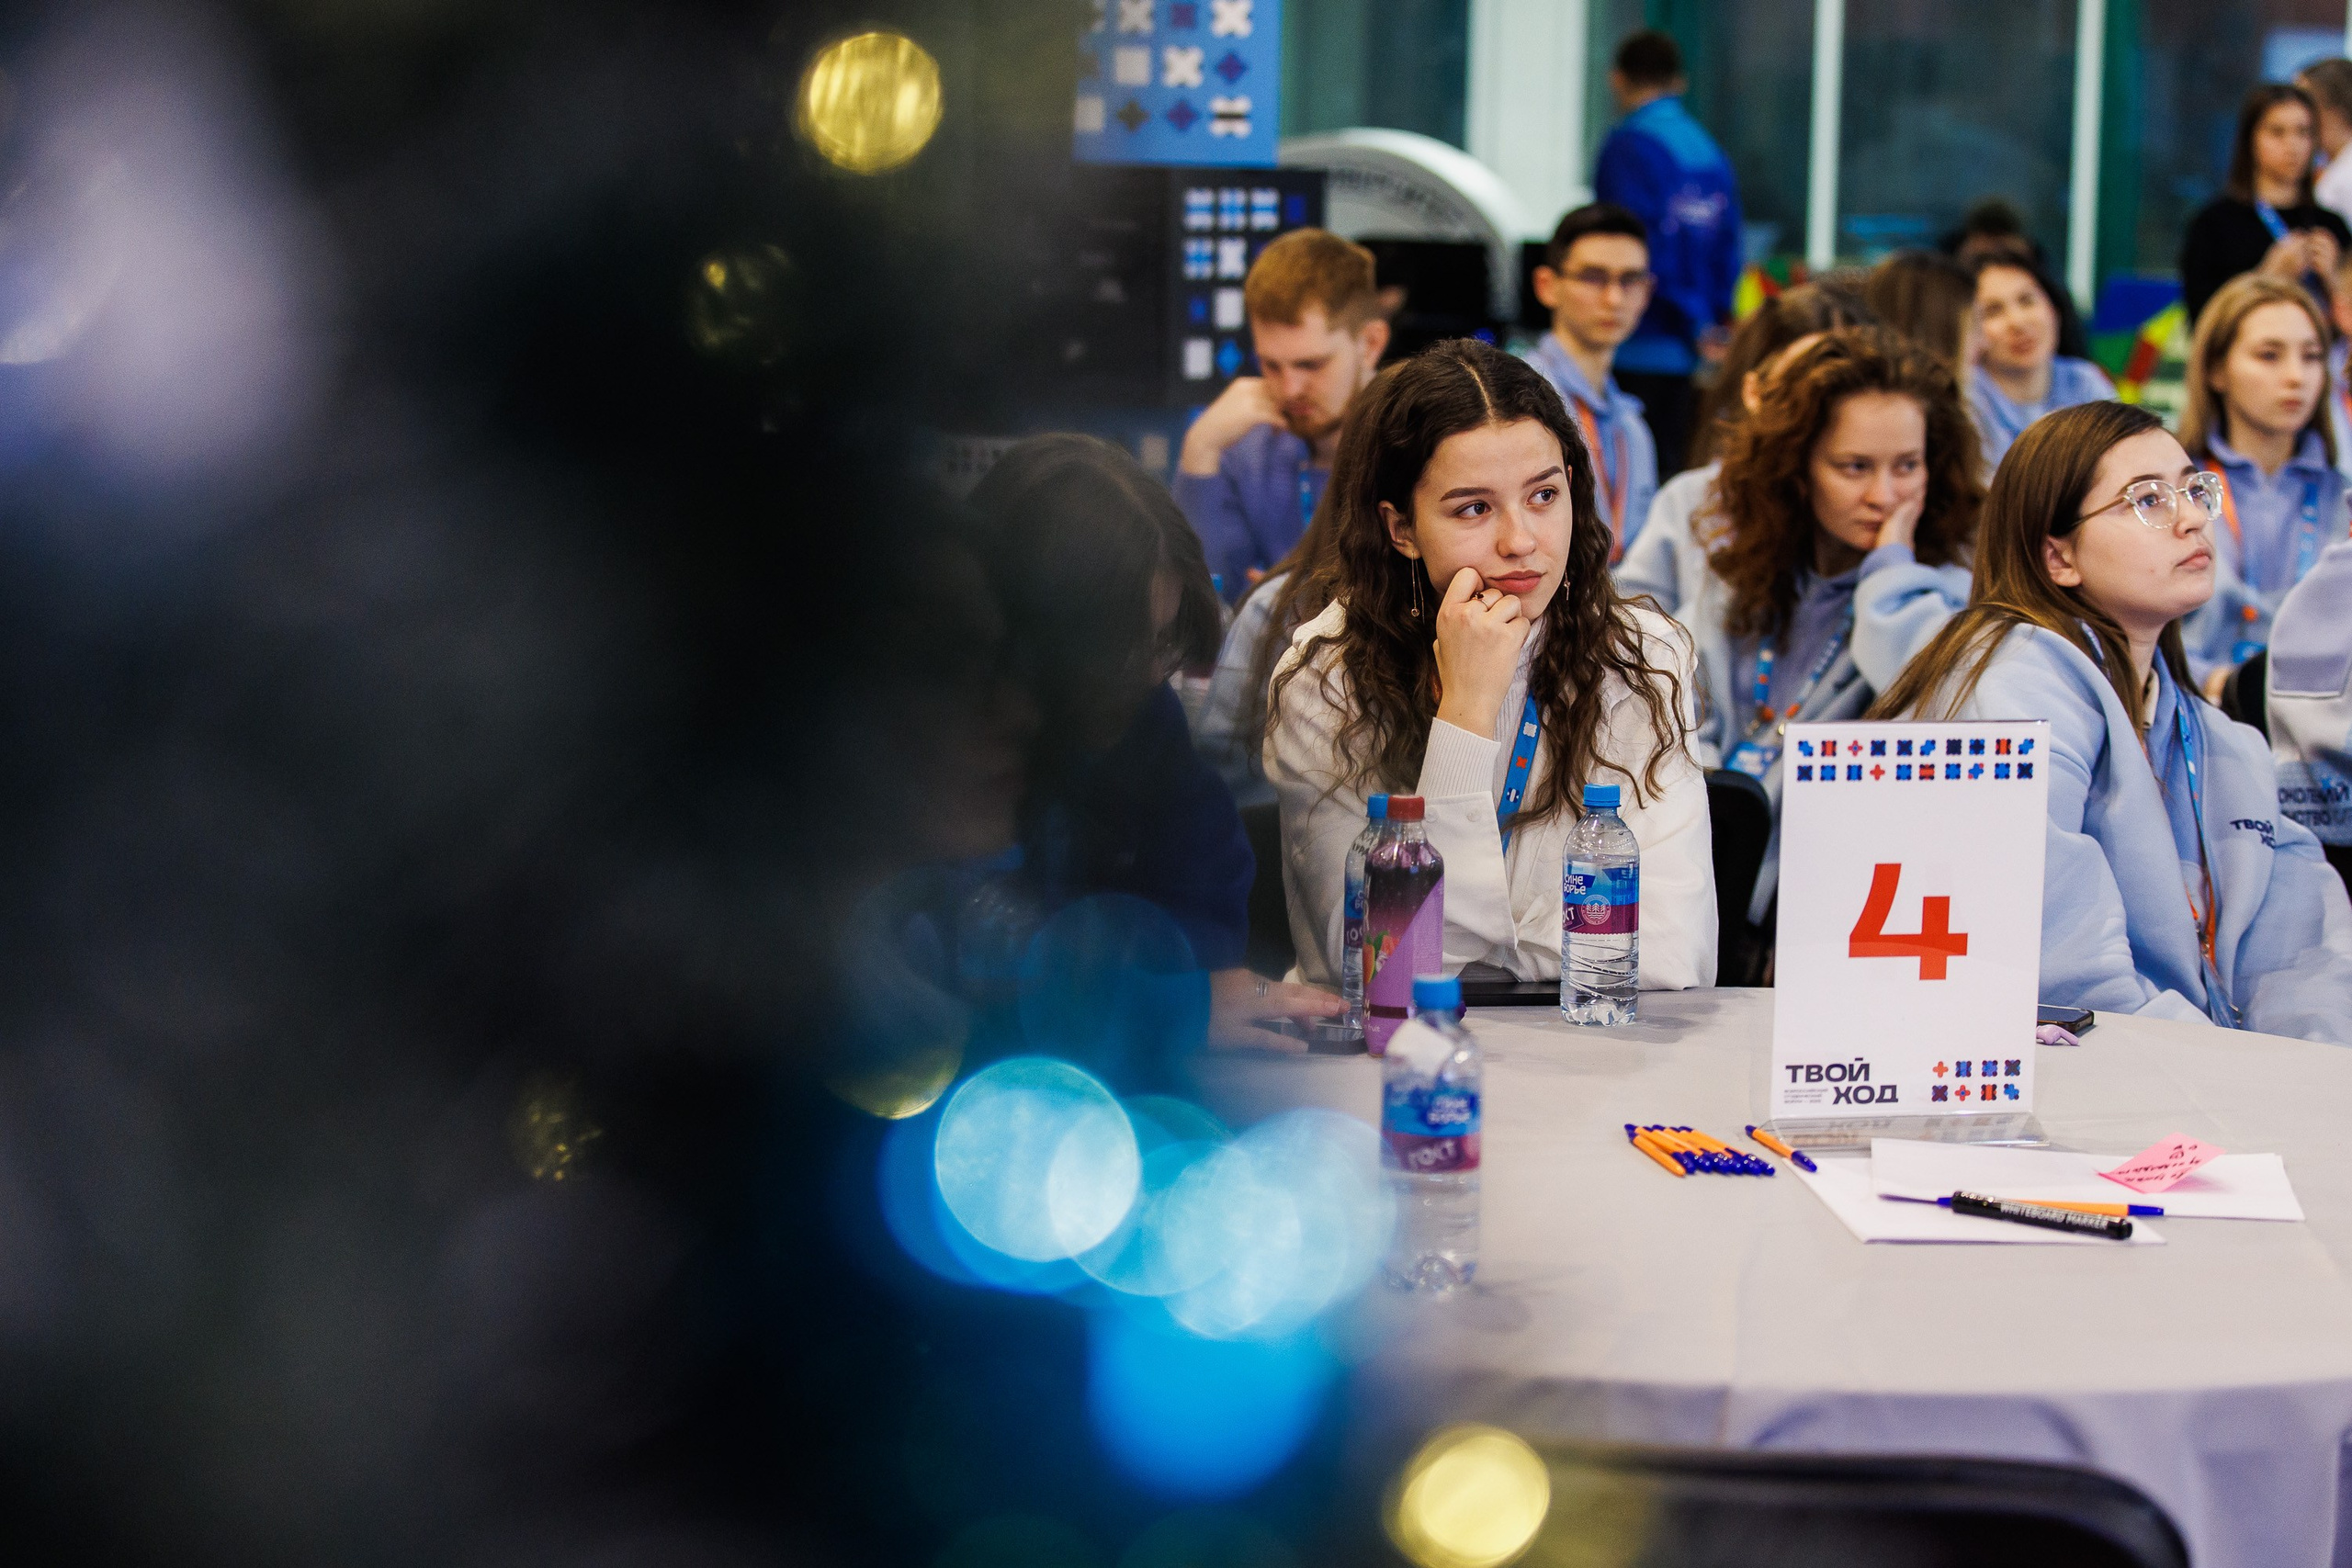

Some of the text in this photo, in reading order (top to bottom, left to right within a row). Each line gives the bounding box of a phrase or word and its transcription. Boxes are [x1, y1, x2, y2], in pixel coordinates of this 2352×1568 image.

[2230, 818, 2275, 835] ТВОЙ
[1849, 863, 1969, 981] 4
[1785, 1057, 1870, 1083] ТВОЙ
[1832, 1084, 1899, 1105] ХОД
[2000, 1201, 2109, 1230] WHITEBOARD MARKER
